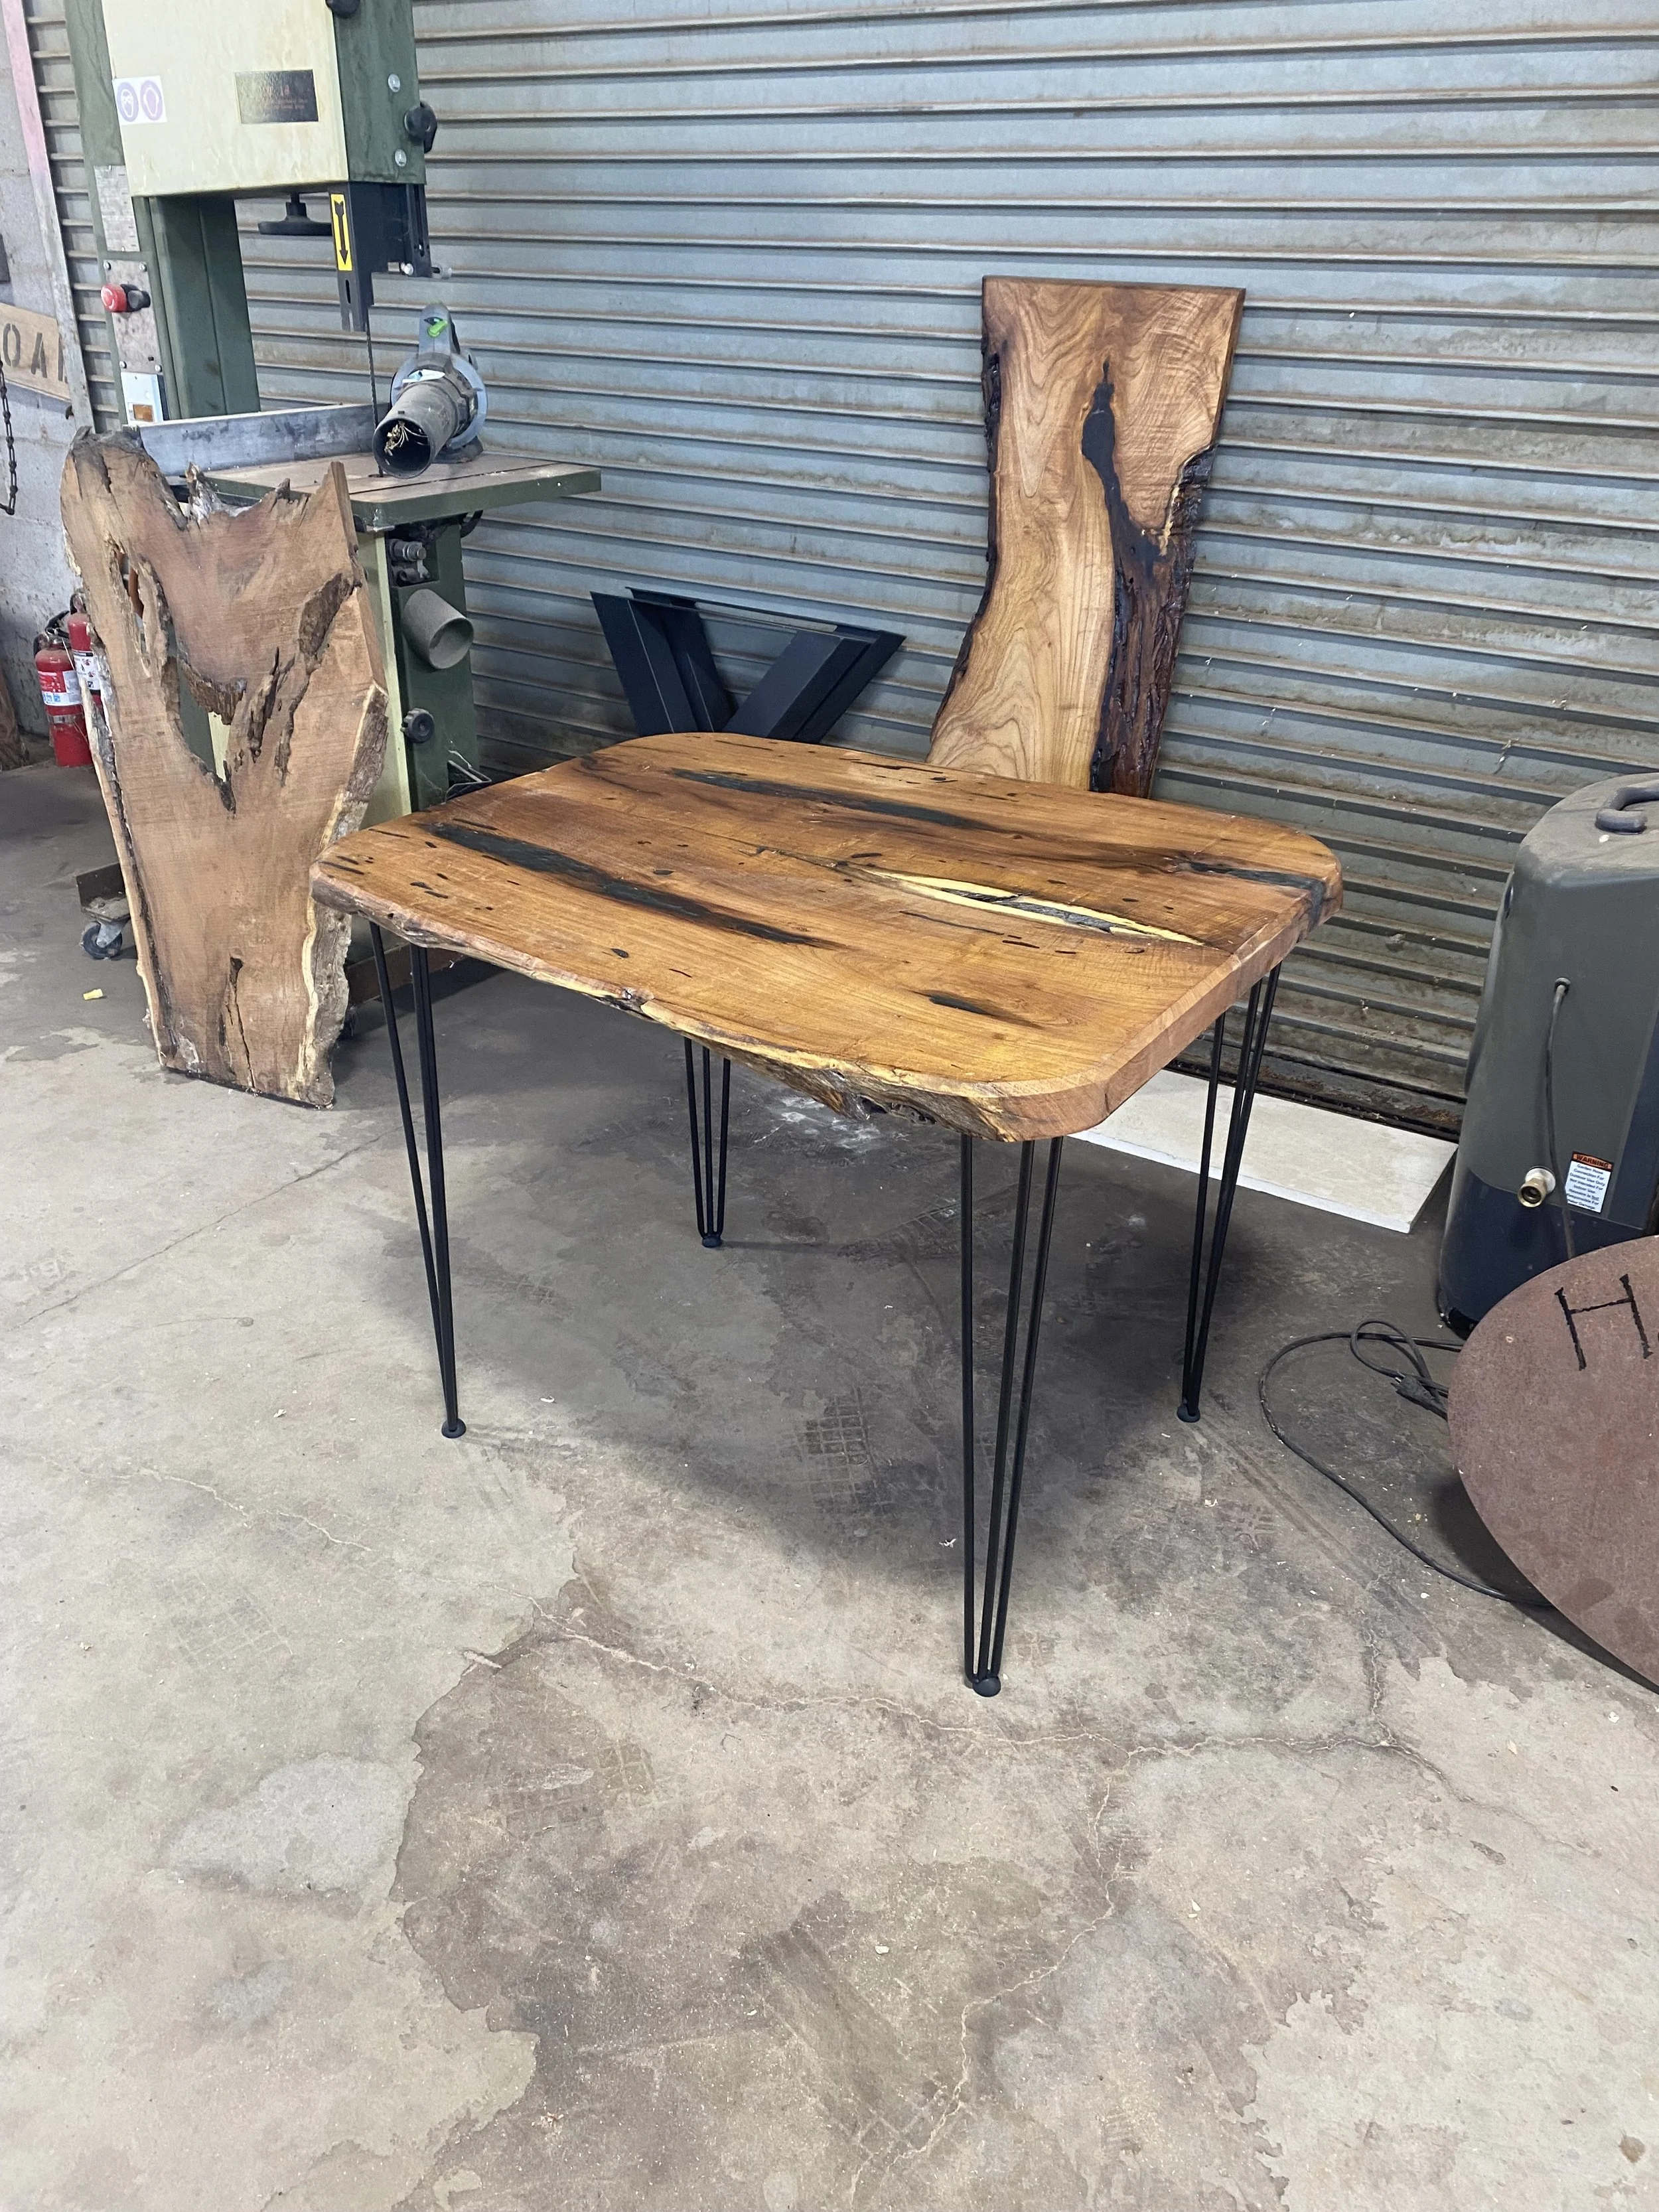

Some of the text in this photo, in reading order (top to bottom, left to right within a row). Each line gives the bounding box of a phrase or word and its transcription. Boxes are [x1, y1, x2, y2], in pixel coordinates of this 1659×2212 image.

[1576, 1155, 1609, 1168] WARNING
[1574, 1169, 1597, 1177] Connection
[1554, 1274, 1659, 1371] H
